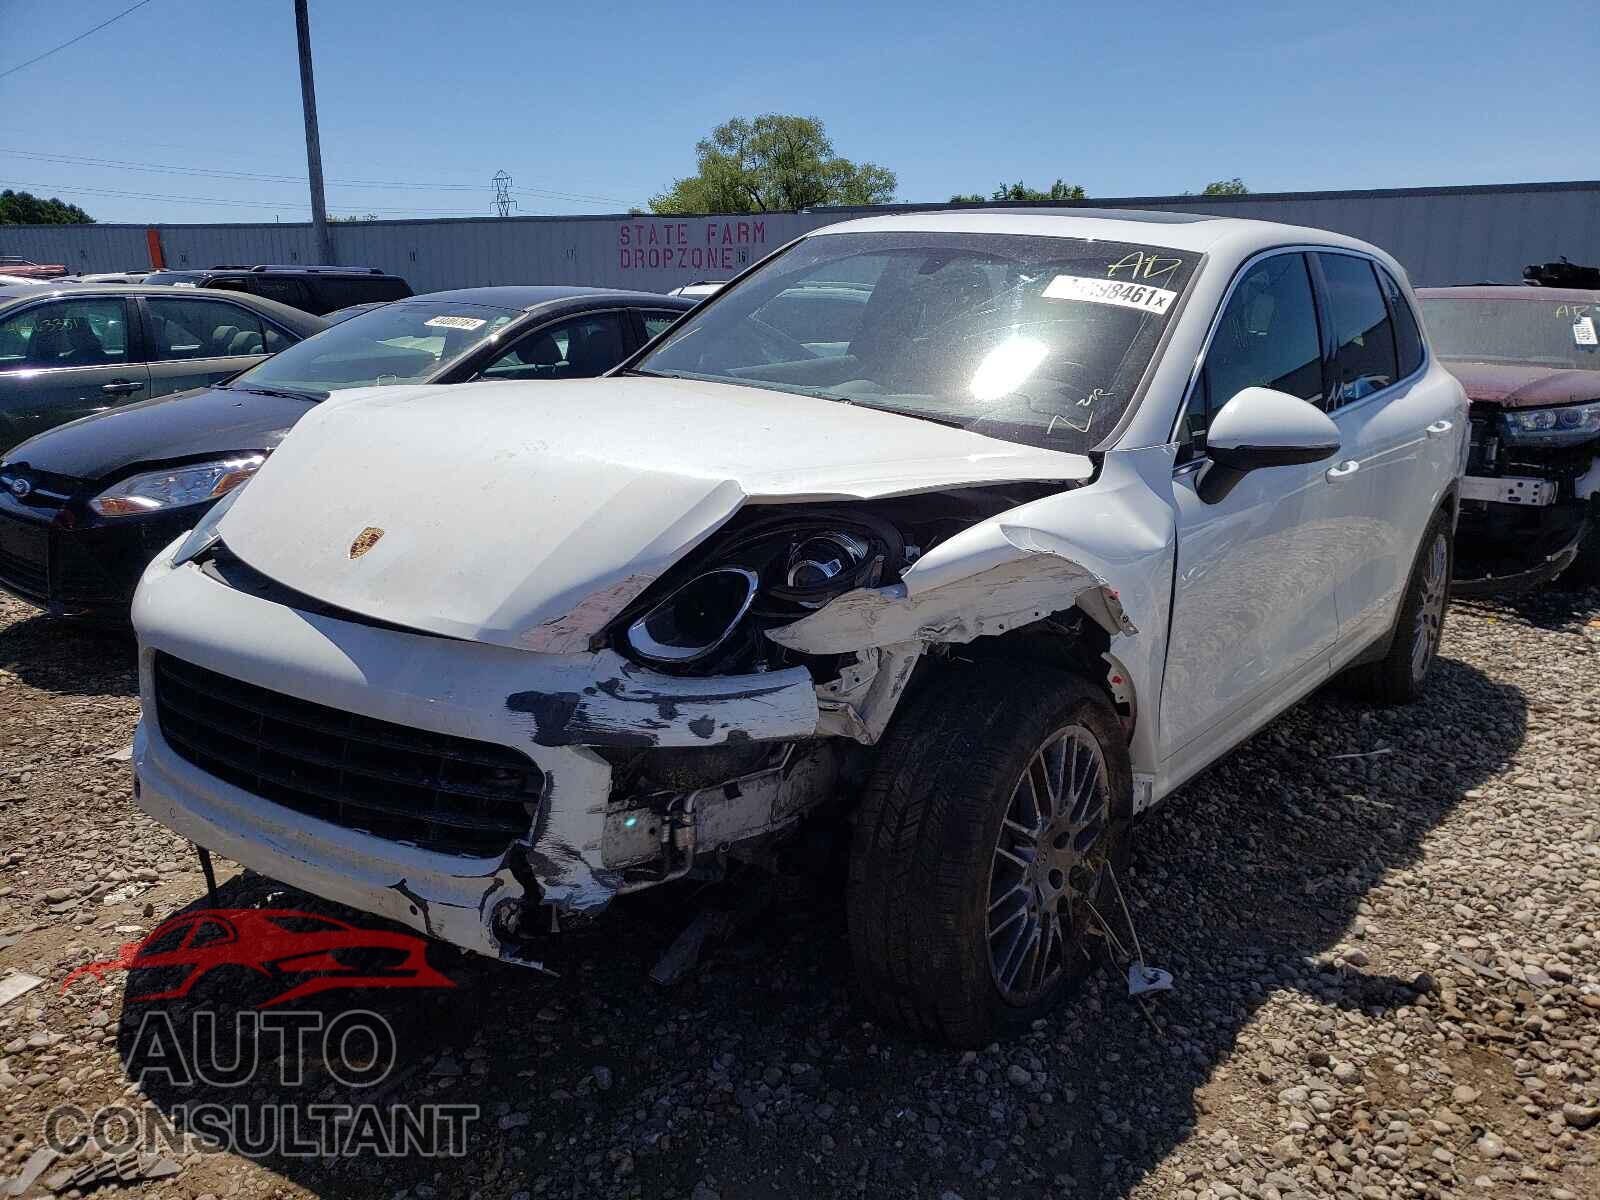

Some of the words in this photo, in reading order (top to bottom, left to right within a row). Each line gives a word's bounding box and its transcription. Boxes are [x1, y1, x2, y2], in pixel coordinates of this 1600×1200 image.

[620, 223, 688, 245] STATE
[707, 221, 765, 244] FARM
[620, 247, 733, 269] DROPZONE
